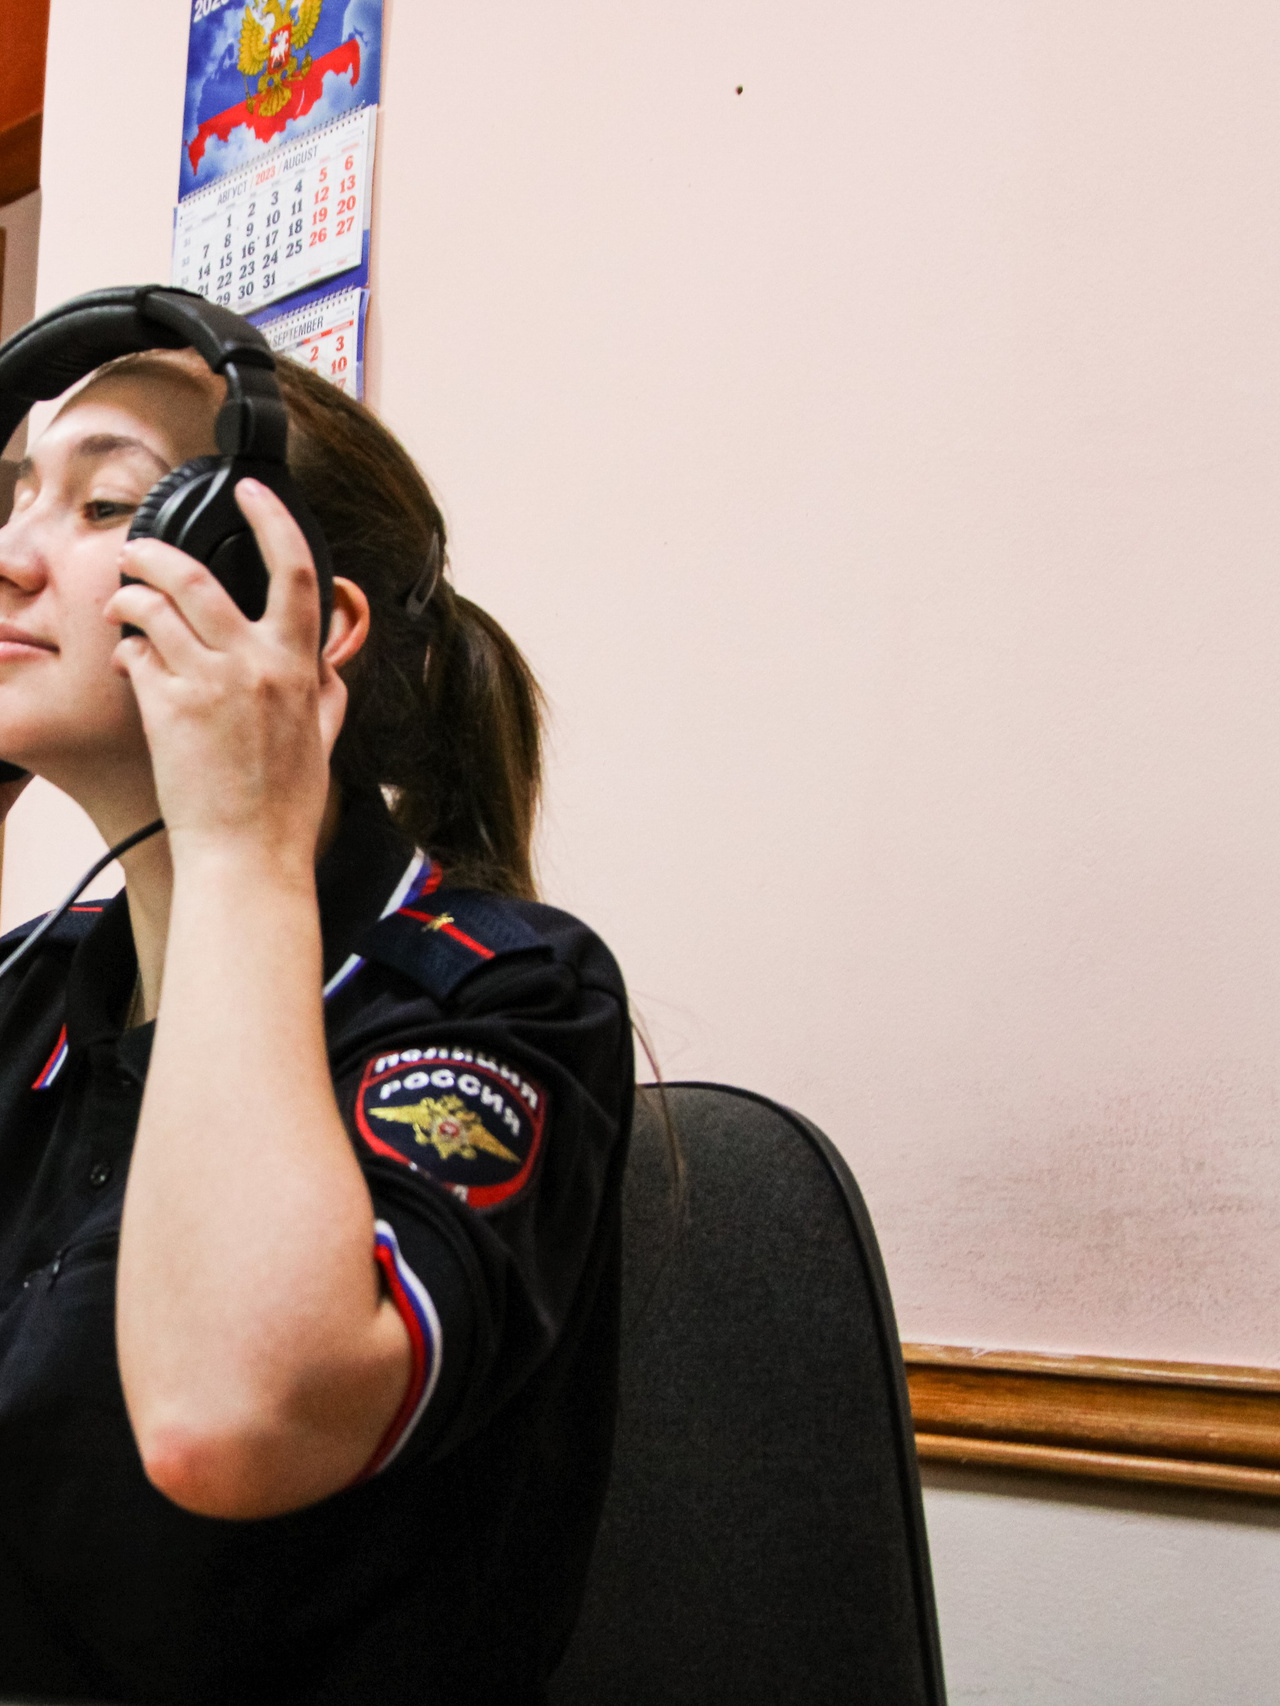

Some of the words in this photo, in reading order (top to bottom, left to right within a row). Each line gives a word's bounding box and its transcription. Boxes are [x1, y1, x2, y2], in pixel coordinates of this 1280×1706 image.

[193, 0, 229, 23] 202
[217, 180, 248, 206] АВГУСТ
[255, 165, 276, 186] 2023
[283, 144, 318, 172] AUGUST
[227, 214, 232, 228] 1
[247, 202, 256, 218] 2
[271, 190, 279, 206] 3
[294, 179, 302, 193] 4
[319, 166, 327, 183] 5
[345, 154, 354, 171] 6
[198, 262, 211, 280] 14
[220, 251, 233, 270] 15
[241, 241, 256, 259] 16
[265, 229, 279, 248] 17
[288, 218, 302, 238] 18
[312, 206, 328, 226] 19
[336, 195, 356, 216] 20
[203, 243, 210, 259] 7
[224, 233, 232, 248] 8
[246, 222, 254, 237] 9
[266, 209, 281, 228] 10
[291, 198, 302, 216] 11
[314, 186, 330, 206] 12
[340, 174, 356, 194] 13
[198, 282, 209, 296] 21
[217, 271, 232, 290] 22
[239, 260, 255, 280] 23
[262, 249, 278, 270] 24
[286, 238, 302, 259] 25
[309, 227, 327, 248] 26
[336, 216, 355, 237] 27
[238, 281, 254, 299] 30
[262, 270, 276, 289] 31
[272, 315, 324, 348] SEPTEMBER
[310, 346, 319, 363] 2
[336, 335, 344, 352] 3
[331, 356, 348, 375] 10
[380, 1069, 520, 1137] РОССИЯ
